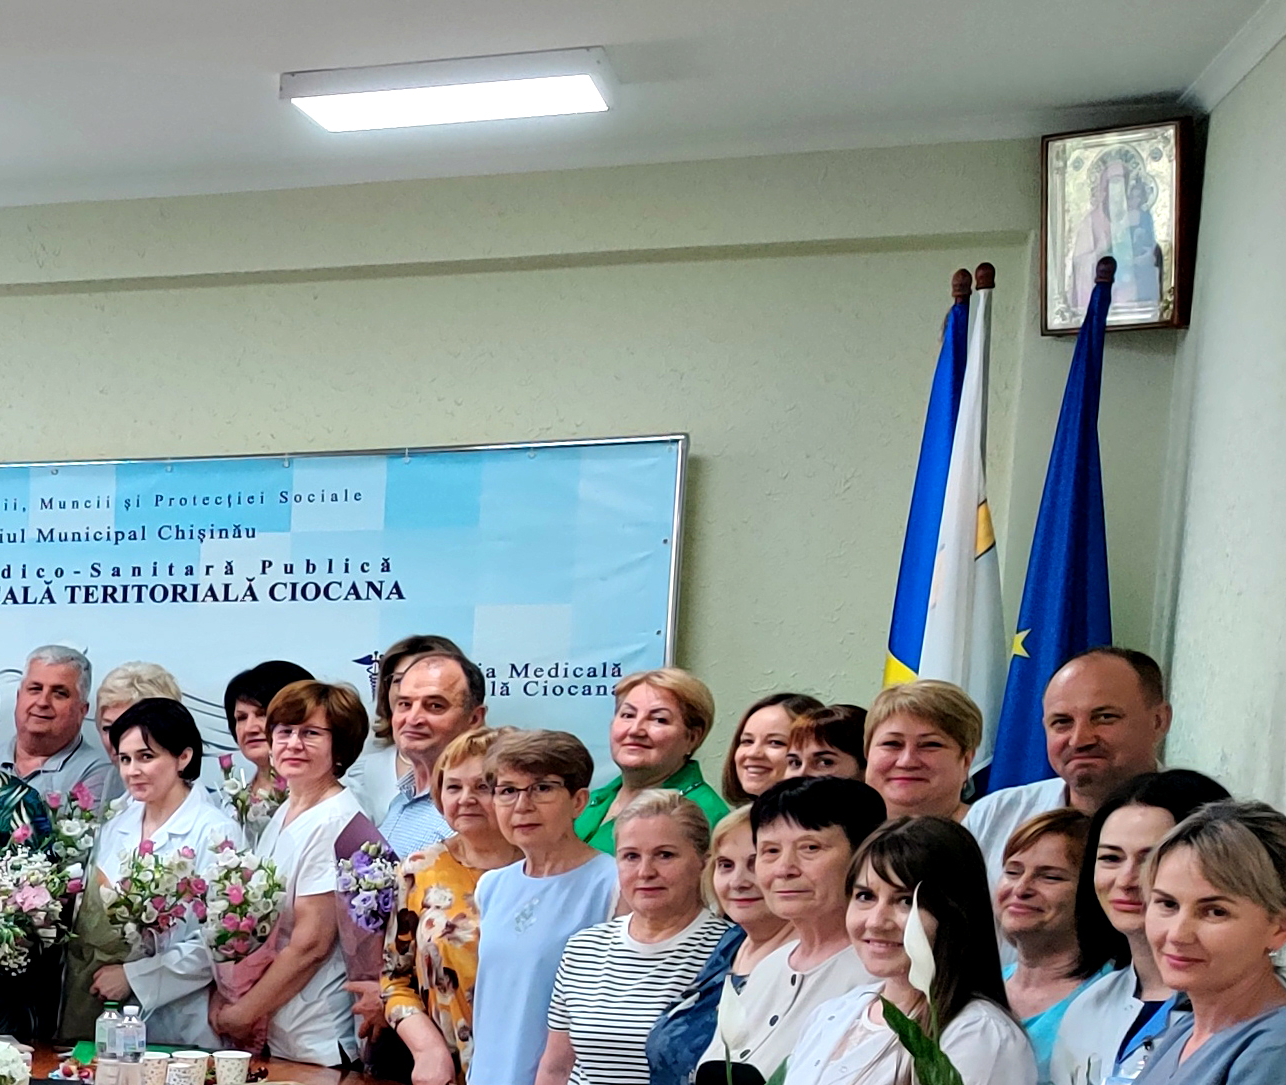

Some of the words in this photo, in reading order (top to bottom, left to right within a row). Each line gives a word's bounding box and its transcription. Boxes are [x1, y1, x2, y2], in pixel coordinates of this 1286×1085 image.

[39, 496, 112, 511] Muncii
[279, 489, 363, 504] Sociale
[36, 526, 147, 545] Municipal
[260, 556, 392, 576] Publică
[64, 577, 260, 605] TERITORIALĂ
[268, 580, 406, 602] CIOCANA
[508, 662, 623, 679] Medicală
